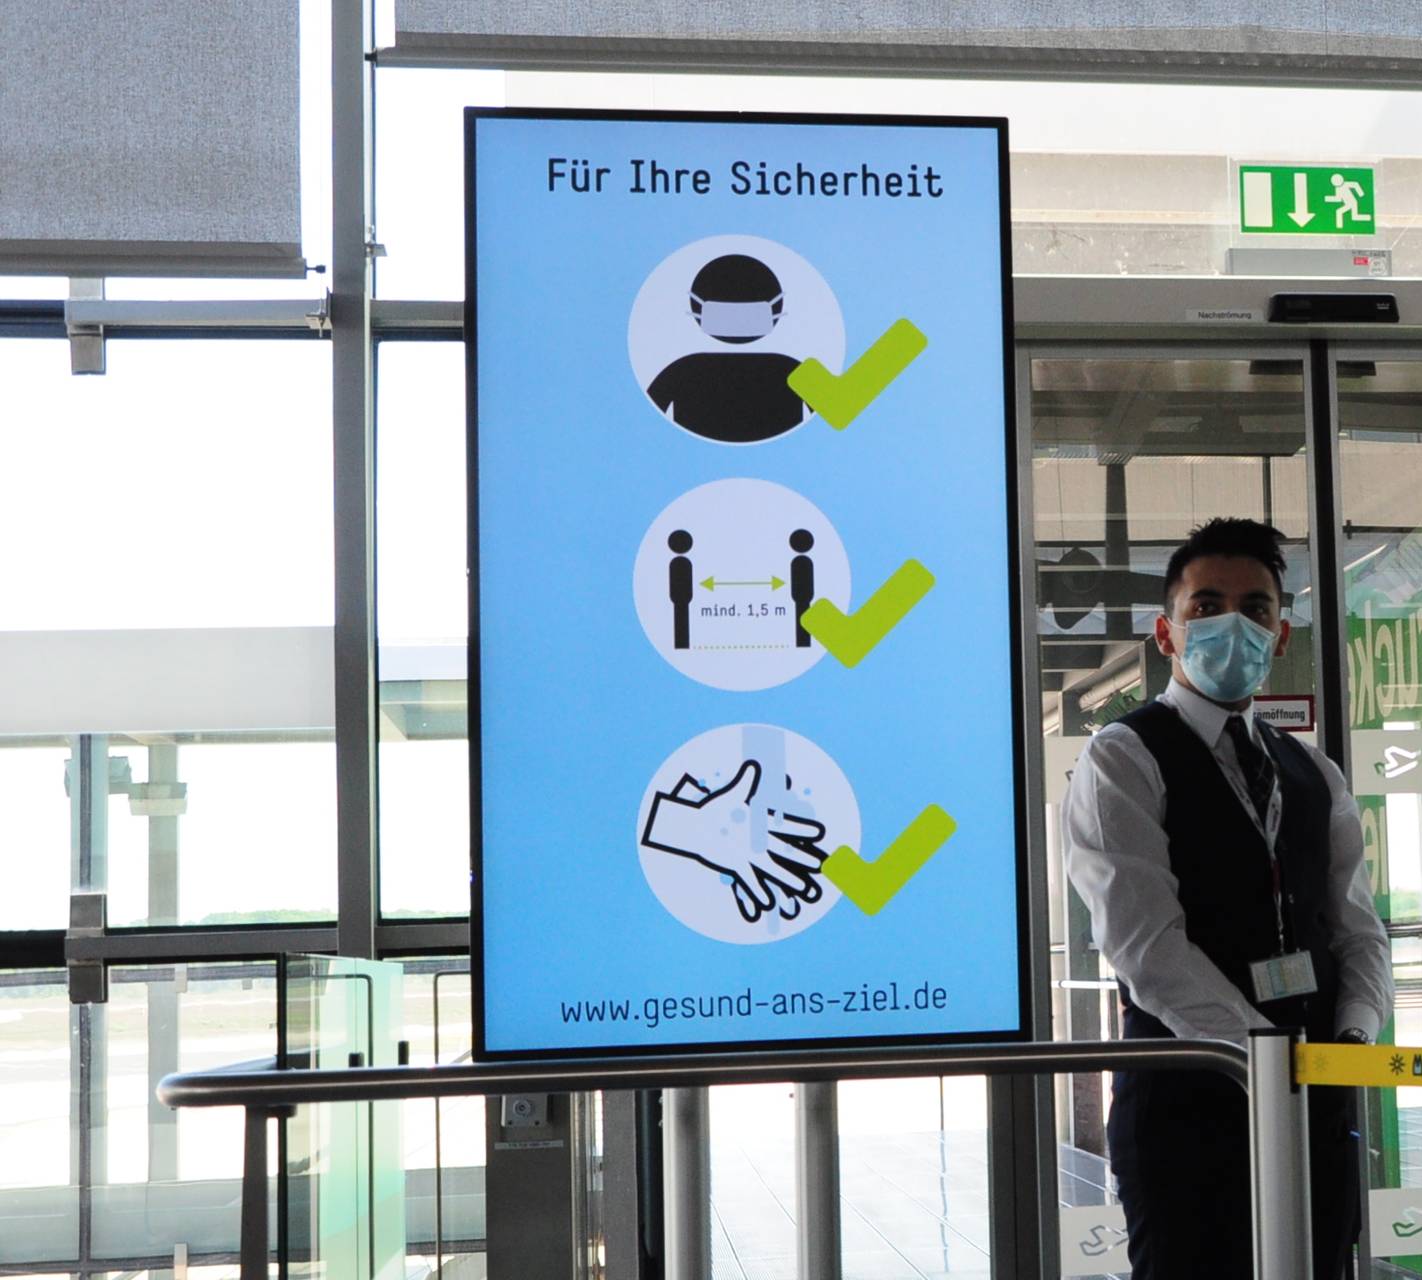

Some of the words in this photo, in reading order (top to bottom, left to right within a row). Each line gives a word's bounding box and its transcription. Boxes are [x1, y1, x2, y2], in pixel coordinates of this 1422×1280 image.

[547, 157, 612, 193] Für
[629, 159, 712, 195] Ihre
[730, 160, 944, 198] Sicherheit
[701, 603, 742, 617] mind.
[747, 603, 769, 619] 1,5
[774, 606, 787, 617] m
[561, 981, 949, 1028] www.gesund-ans-ziel.de
